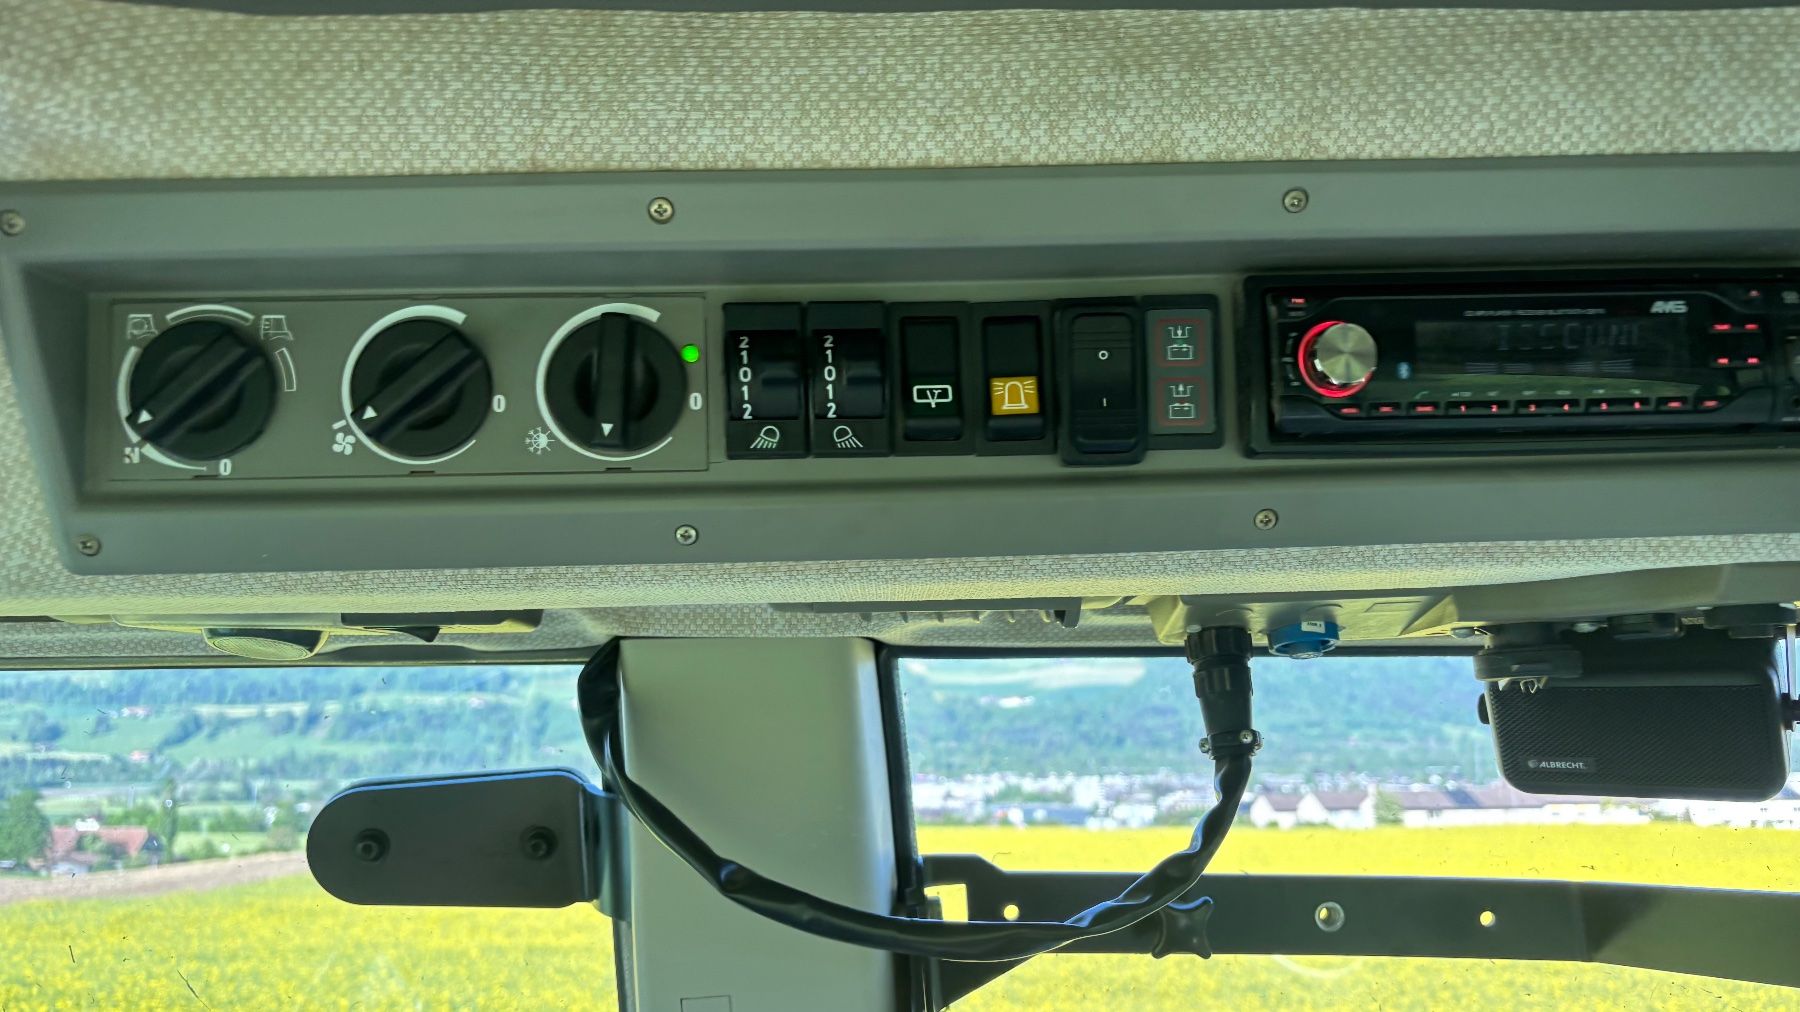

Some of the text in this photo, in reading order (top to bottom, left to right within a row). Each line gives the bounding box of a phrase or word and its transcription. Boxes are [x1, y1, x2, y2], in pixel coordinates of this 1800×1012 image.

[738, 336, 750, 349] 2
[823, 335, 834, 348] 2
[740, 349, 749, 365] 1
[825, 349, 833, 364] 1
[741, 385, 749, 402] 1
[826, 383, 834, 400] 1
[492, 394, 506, 413] 0
[689, 392, 703, 411] 0
[742, 403, 753, 420] 2
[826, 402, 837, 419] 2
[219, 458, 232, 476] 0
[1539, 760, 1586, 770] ALBRECHT
